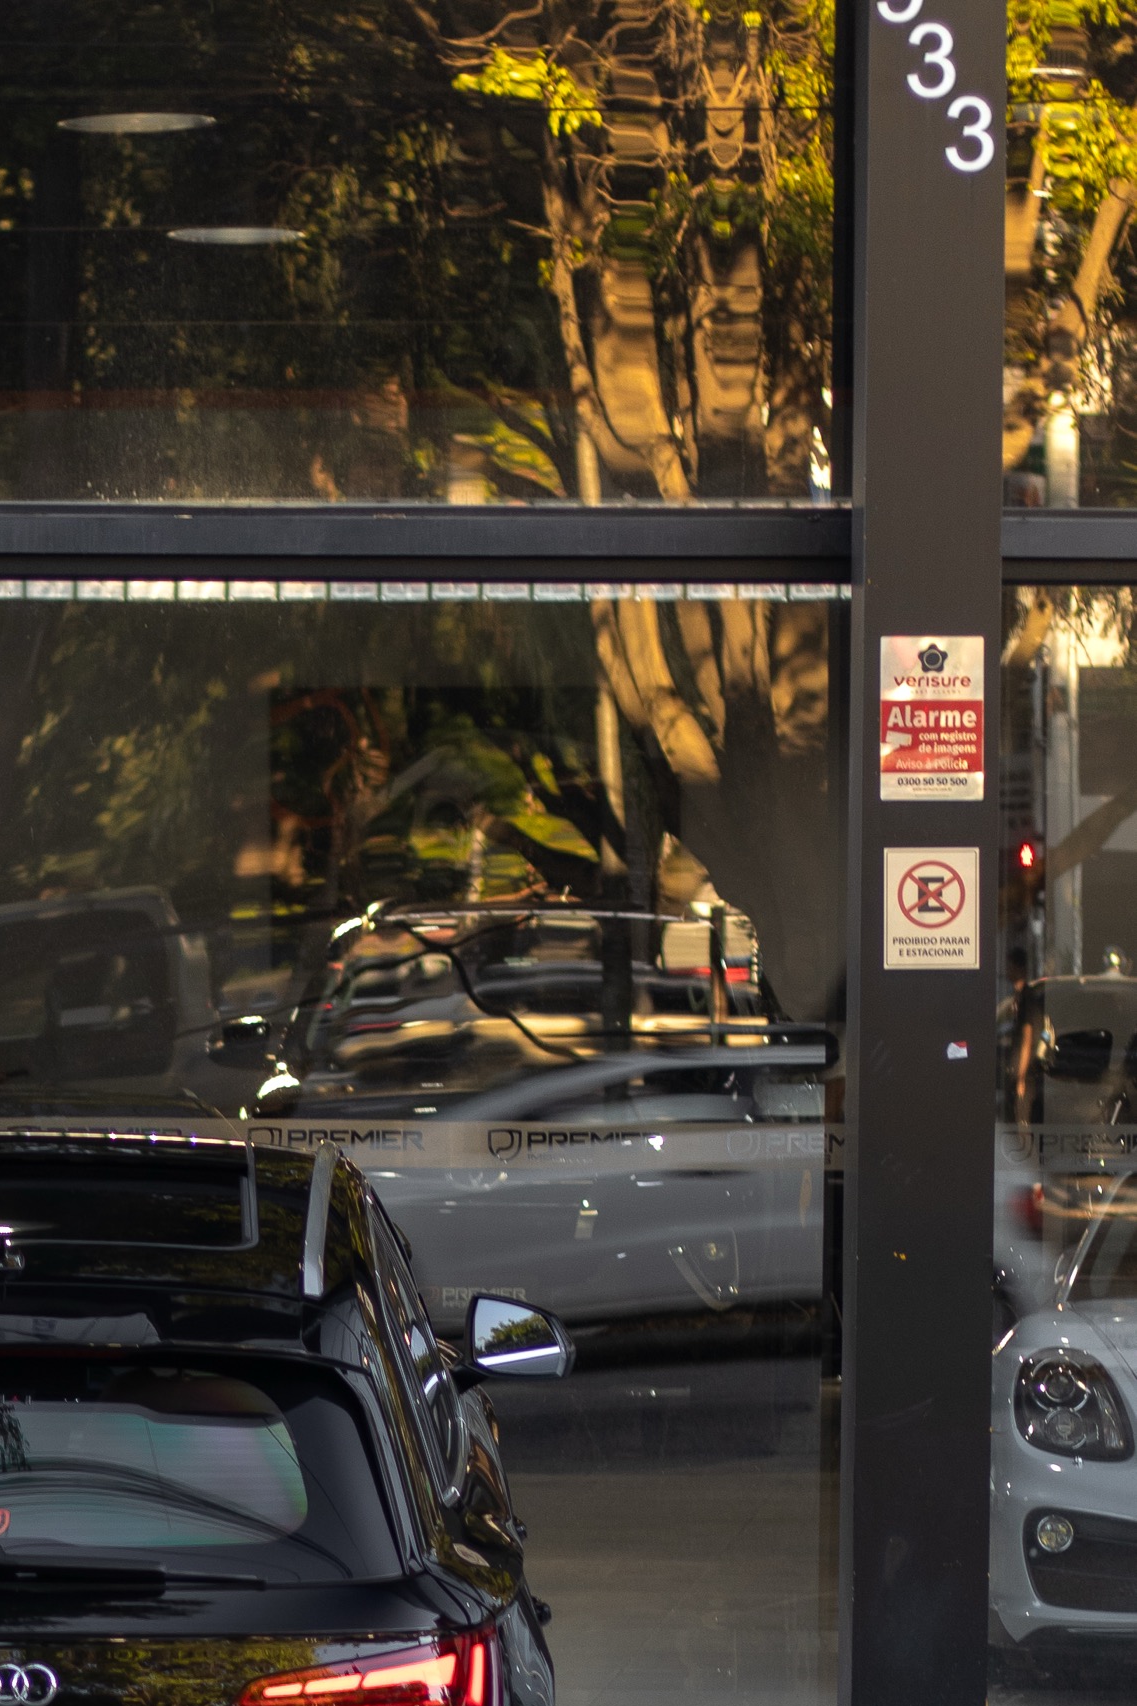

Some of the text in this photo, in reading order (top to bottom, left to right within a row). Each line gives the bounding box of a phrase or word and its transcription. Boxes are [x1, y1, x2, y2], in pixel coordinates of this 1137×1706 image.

[876, 0, 995, 173] 33
[894, 675, 971, 687] verisure
[887, 704, 978, 728] Alarme
[918, 730, 977, 743] com registro
[918, 741, 977, 755] de imagens
[896, 758, 922, 769] Aviso
[923, 777, 934, 786] 50
[937, 777, 948, 786] 50
[950, 777, 967, 786] 500
[893, 936, 970, 945] PROIBIDO PARAR
[899, 948, 964, 956] E ESTACIONAR
[287, 1129, 425, 1151] PREMIER
